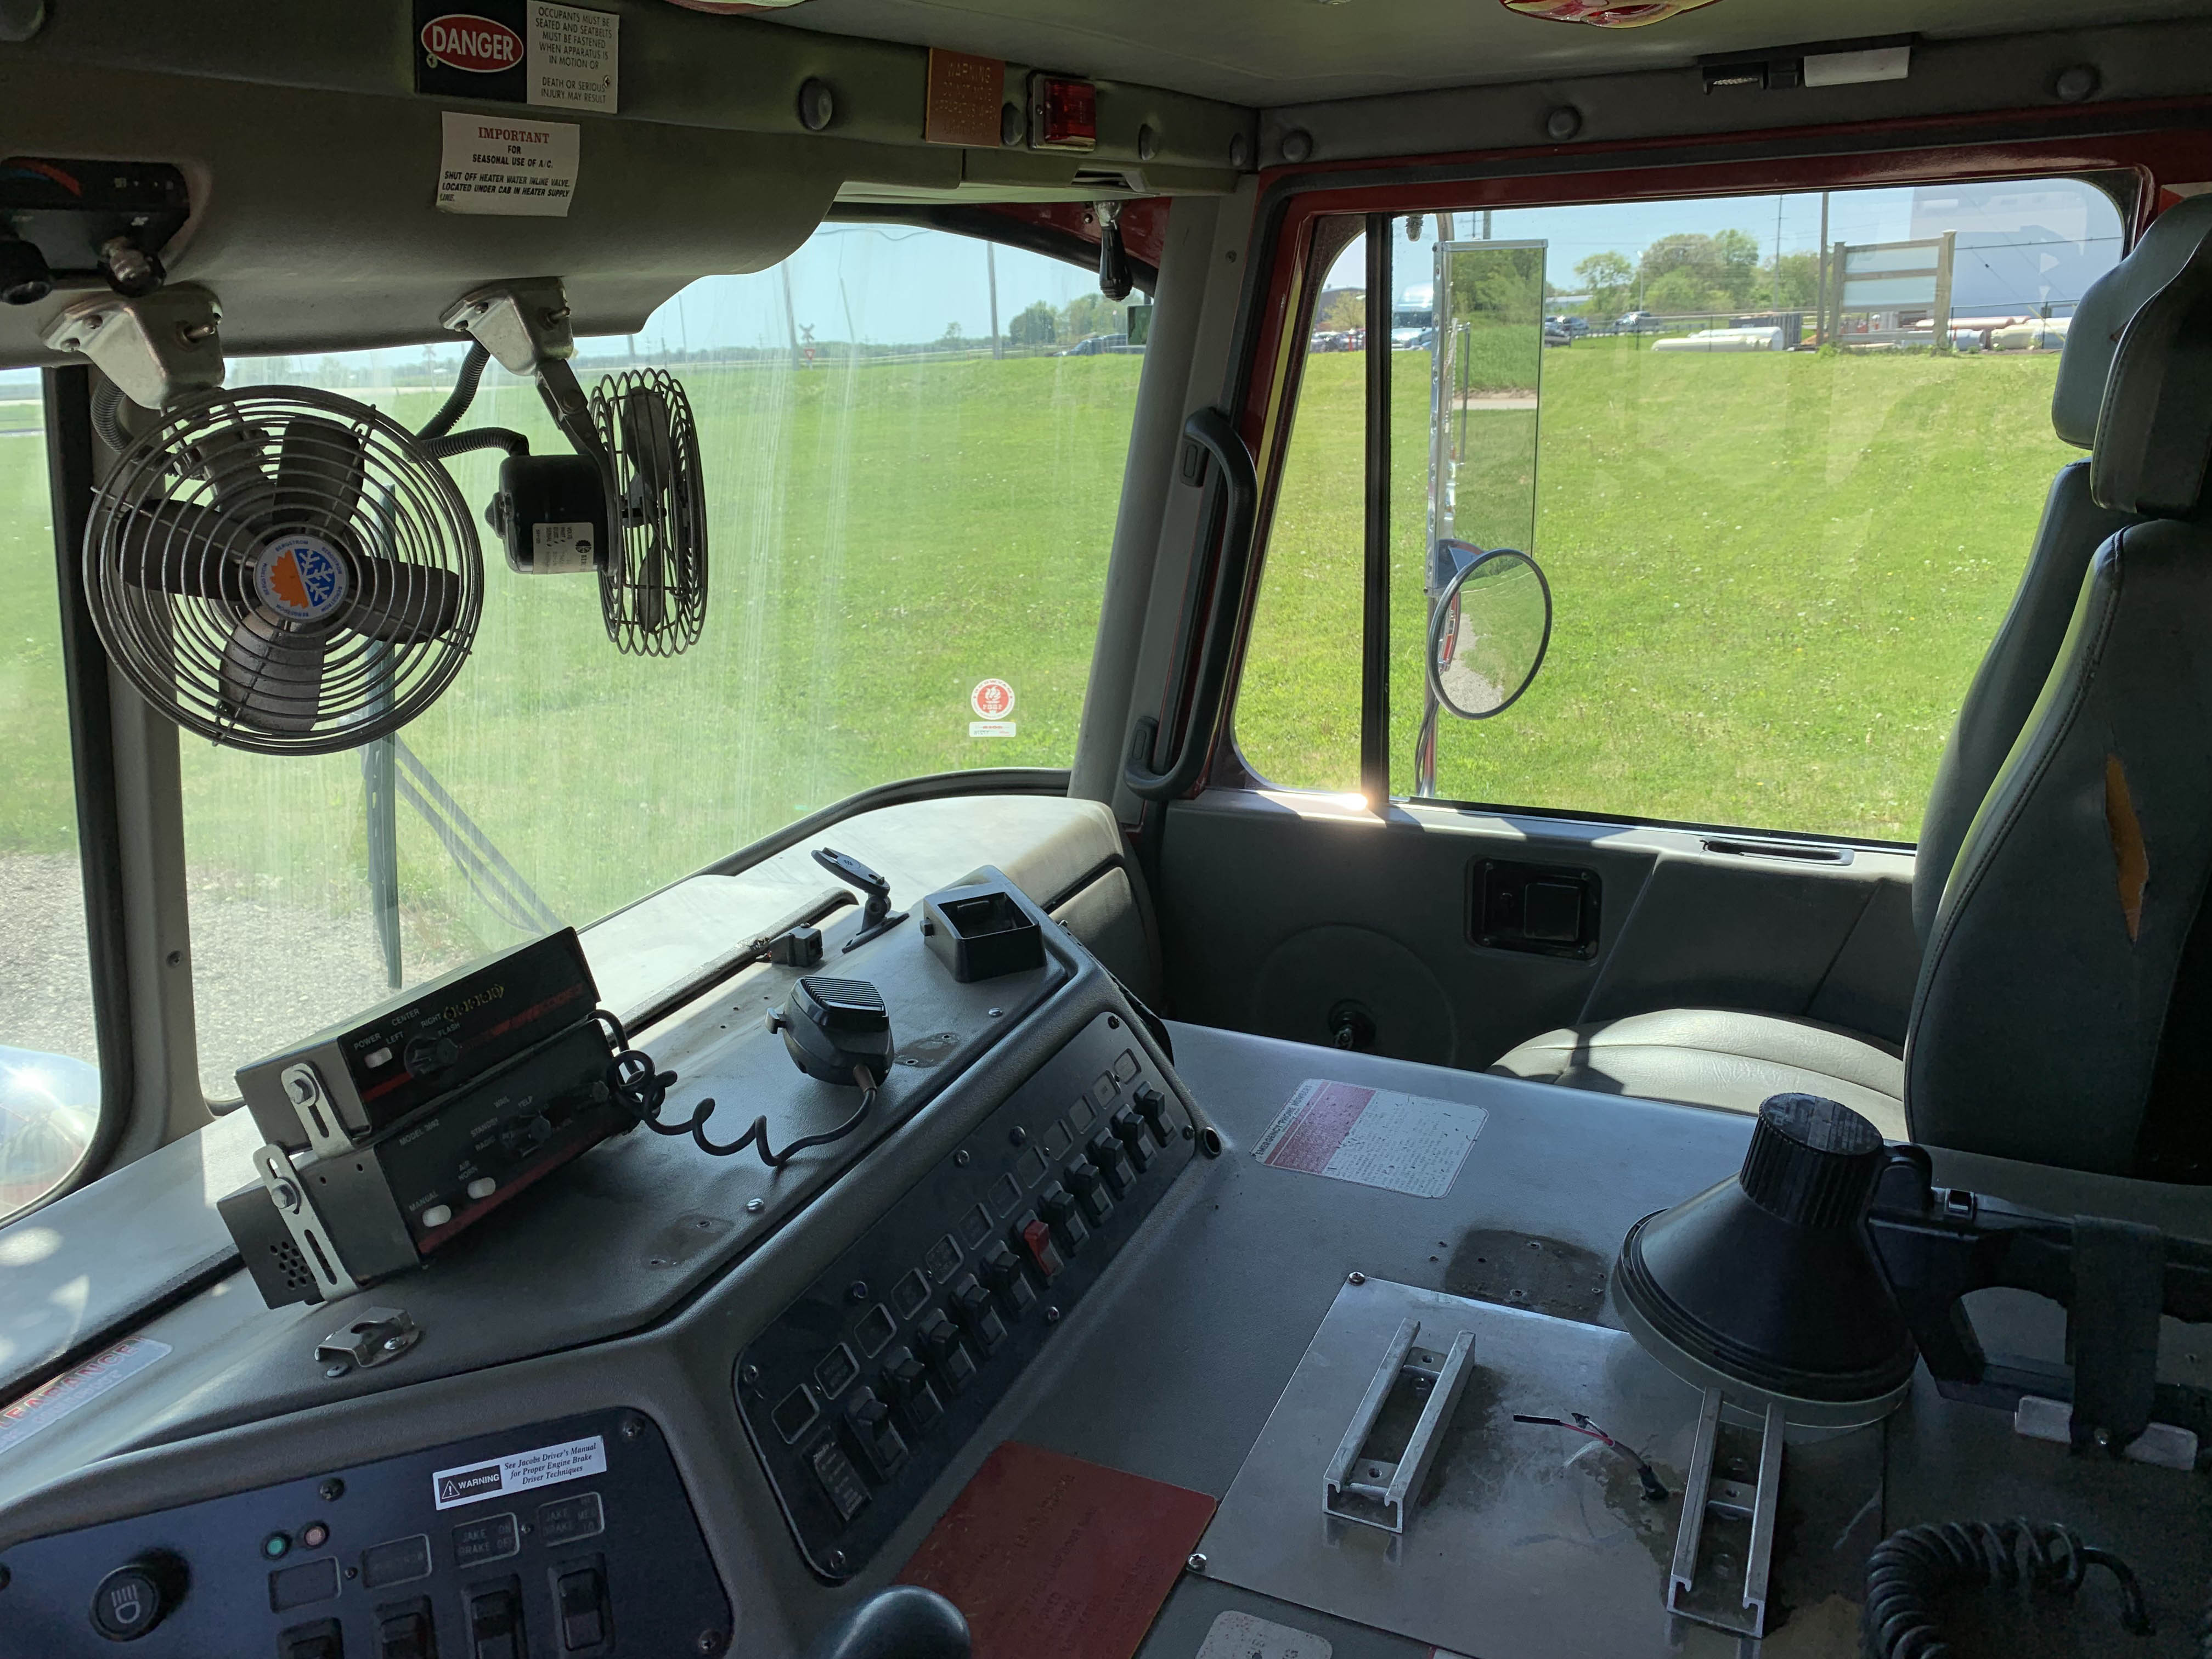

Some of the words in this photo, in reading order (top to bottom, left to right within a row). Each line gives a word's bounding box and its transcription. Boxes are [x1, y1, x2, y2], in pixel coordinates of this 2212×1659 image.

[538, 7, 580, 22] OCCUPANTS
[583, 15, 600, 25] MUST
[602, 18, 610, 27] BE
[535, 18, 560, 30] SEATED
[563, 23, 578, 33] AND
[580, 26, 612, 38] SEATBELTS
[432, 26, 514, 61] DANGER
[543, 31, 561, 42] MUST
[564, 34, 571, 43] BE
[574, 36, 606, 49] FASTENED
[539, 42, 561, 53] WHEN
[563, 46, 601, 59] APPARATUS
[603, 52, 608, 60] IS
[549, 55, 557, 64] IN
[559, 57, 587, 69] MOTION
[542, 77, 564, 88] DEATH
[566, 80, 575, 89] OR
[578, 81, 606, 92] SERIOUS
[541, 88, 565, 99] INJURY
[567, 92, 581, 101] MAY
[584, 93, 606, 103] RESULT
[478, 127, 549, 144] IMPORTANT
[507, 145, 521, 155] FOR
[472, 154, 509, 165] SEASONAL
[511, 157, 525, 166] USE
[527, 159, 537, 168] OF
[445, 171, 462, 180] SHUT
[464, 172, 477, 182] OFF
[479, 173, 504, 183] HEATER
[506, 176, 527, 184] WATER
[442, 182, 471, 192] LOCATED
[474, 184, 496, 194] UNDER
[498, 185, 511, 195] CAB
[513, 187, 521, 195] IN
[522, 187, 546, 196] HEATER
[547, 189, 569, 198] SUPPLY
[391, 1008, 421, 1027] CENTER
[421, 1012, 442, 1029] RIGHT
[386, 1031, 405, 1045] LEFT
[438, 1022, 461, 1037] FLASH
[353, 1032, 382, 1051] POWER
[399, 1127, 425, 1146] MODEL
[1255, 1120, 1283, 1156] EMERGENCY
[458, 1160, 471, 1172] AIR
[409, 1189, 439, 1212] MANUAL
[504, 1462, 516, 1471] See
[517, 1456, 540, 1469] Jacobs
[542, 1449, 568, 1462] Driver's
[571, 1443, 596, 1455] Manual
[510, 1469, 521, 1480] for
[522, 1464, 545, 1477] Proper
[547, 1459, 571, 1471] Engine
[573, 1455, 592, 1465] Brake
[522, 1475, 544, 1485] Driver
[546, 1465, 583, 1481] Techniques
[458, 1473, 500, 1489] WARNING
[463, 1528, 487, 1542] JAKE
[457, 1541, 491, 1556] BRAKE
